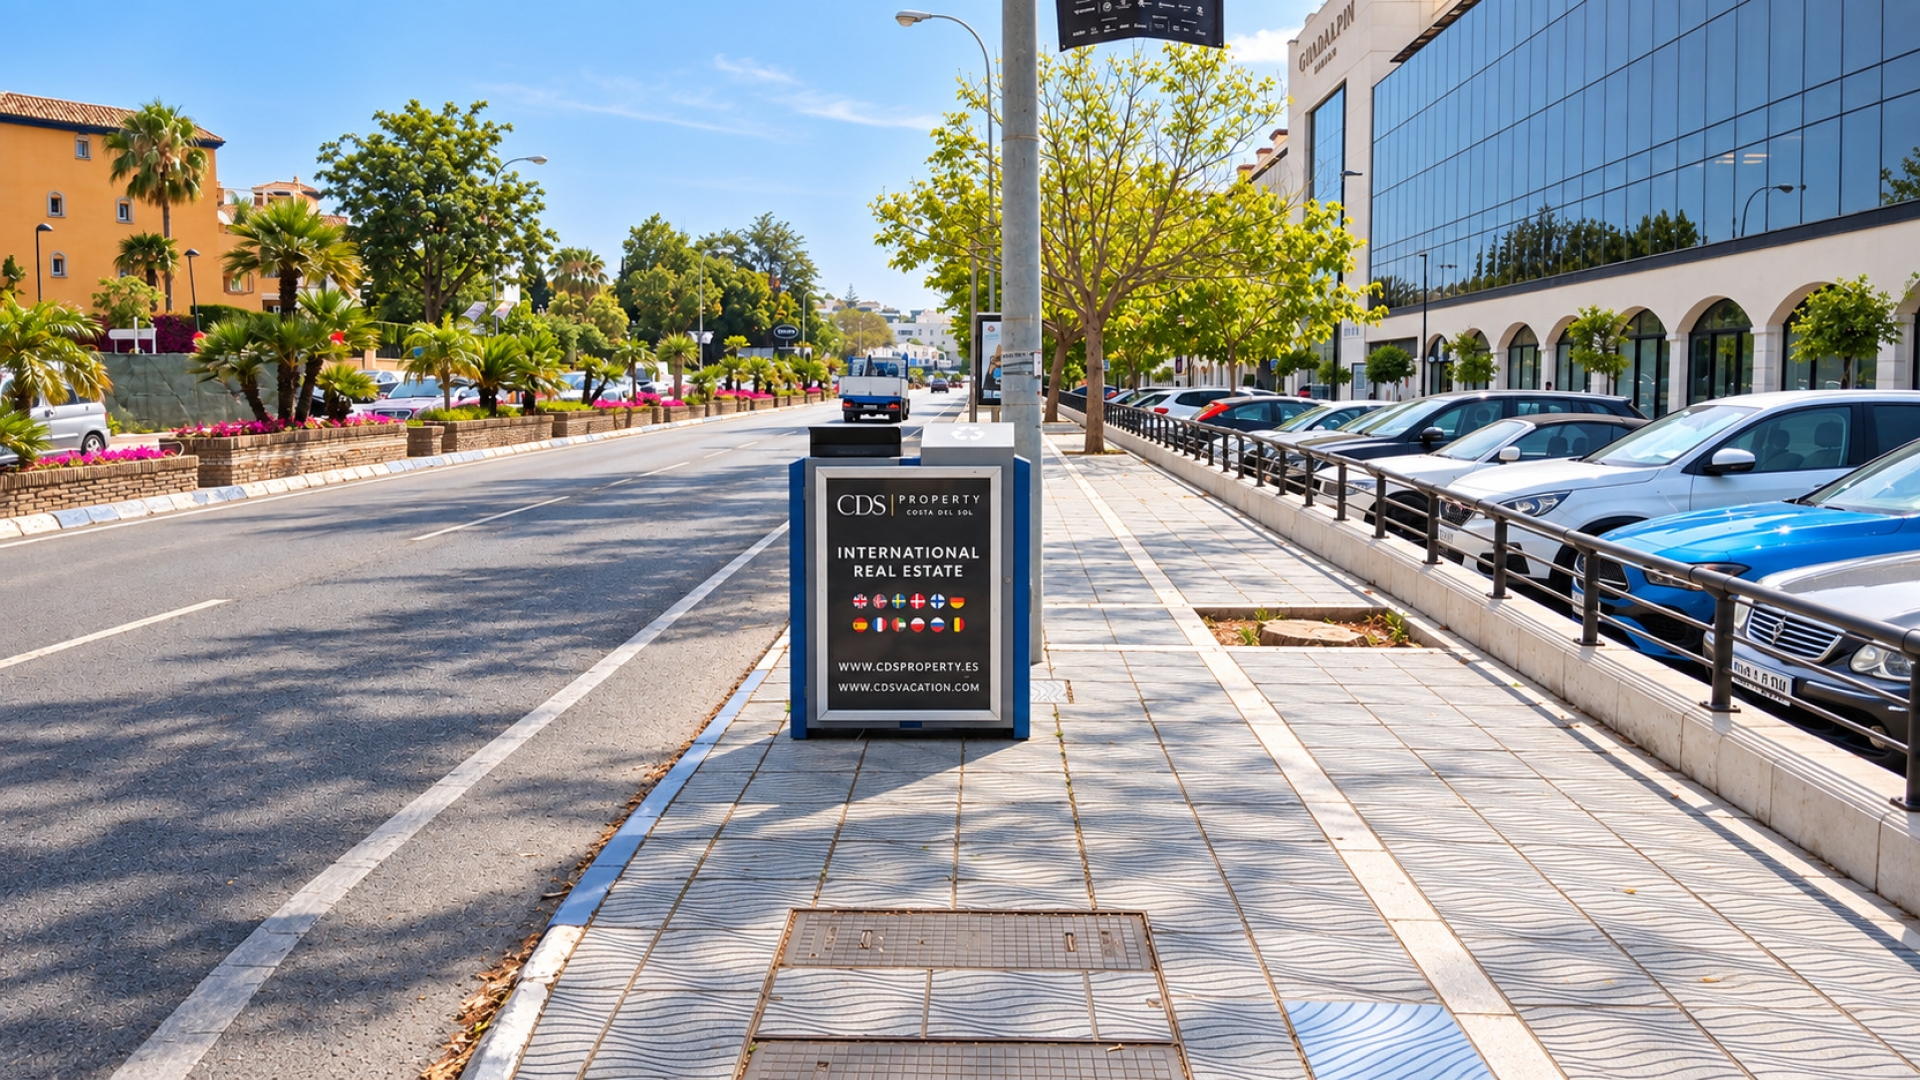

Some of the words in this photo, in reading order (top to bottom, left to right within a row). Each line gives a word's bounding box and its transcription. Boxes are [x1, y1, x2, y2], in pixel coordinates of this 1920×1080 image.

[836, 494, 887, 516] CDS
[899, 494, 981, 505] PROPERTY
[837, 546, 980, 559] INTERNATIONAL
[853, 564, 897, 578] REAL
[902, 564, 964, 578] ESTATE
[838, 661, 979, 672] WWW.CDSPROPERTY.ES
[838, 682, 980, 693] WWW.CDSVACATION.COM
